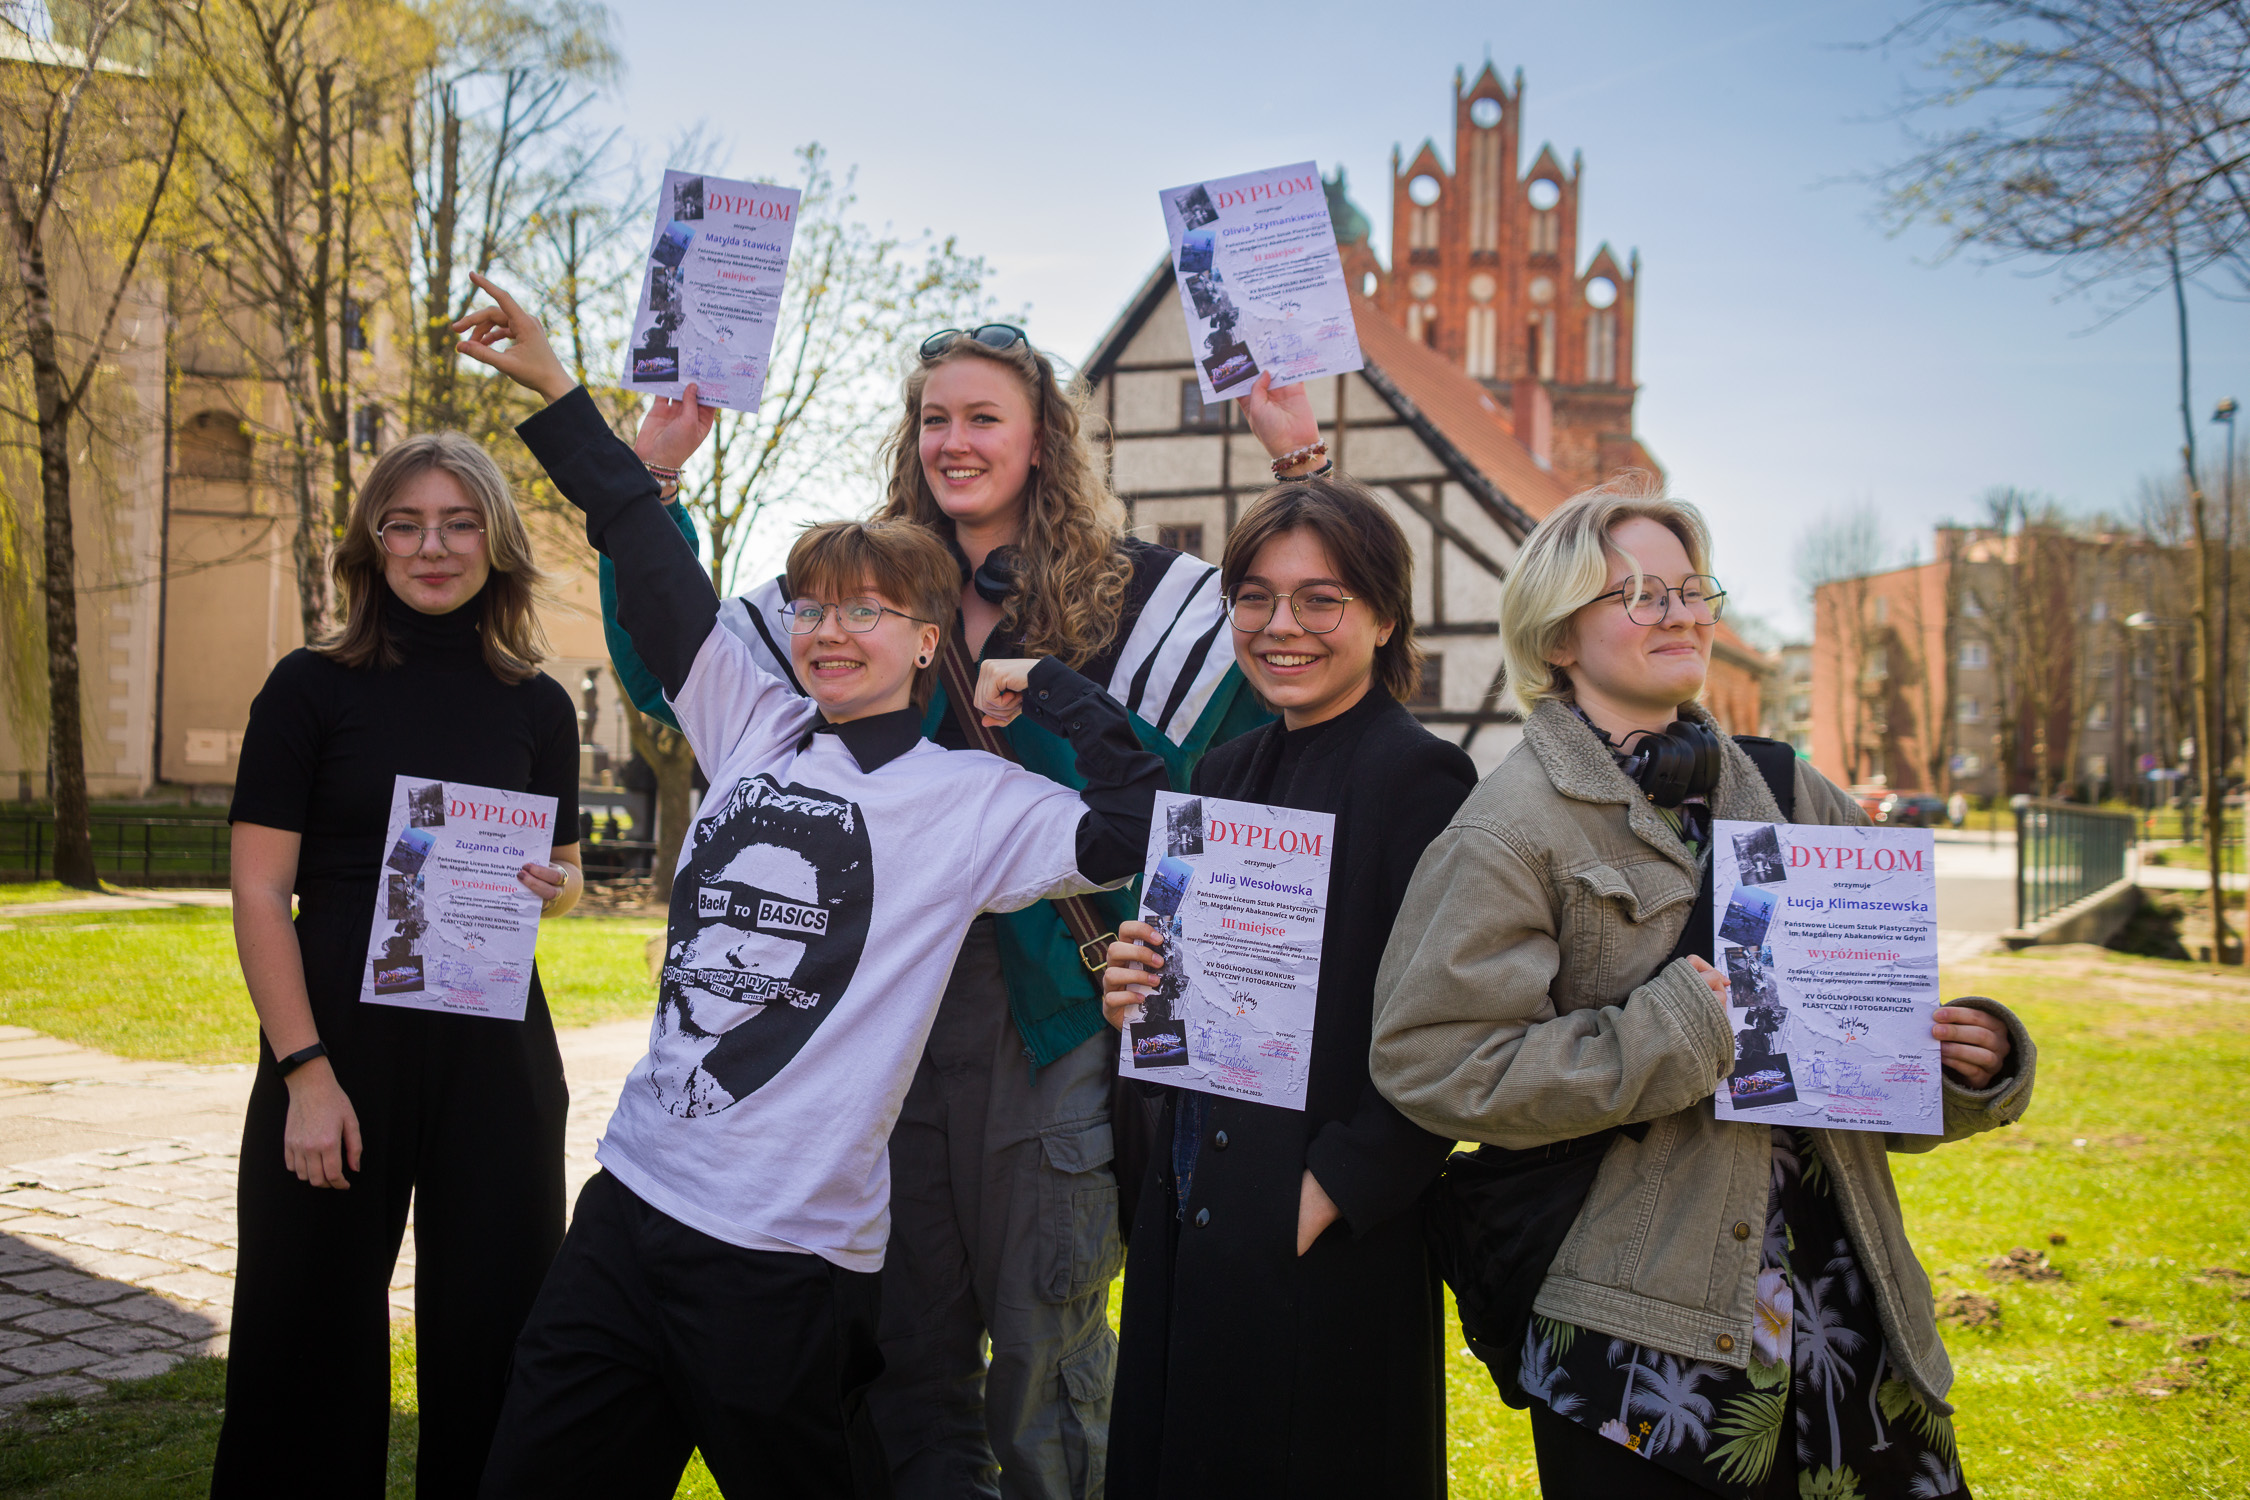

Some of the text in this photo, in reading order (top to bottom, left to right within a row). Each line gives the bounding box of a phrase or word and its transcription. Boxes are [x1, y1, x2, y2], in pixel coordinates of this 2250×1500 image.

[1218, 176, 1314, 208] DYPLOM
[708, 193, 791, 222] DYPLOM
[1222, 210, 1327, 237] Olivia Szymankiewicz
[706, 232, 781, 252] Matylda Stawicka
[722, 270, 756, 282] miejsce
[450, 800, 548, 829] DYPLOM
[1208, 820, 1323, 856] DYPLOM
[455, 840, 525, 857] Zuzanna Ciba
[1244, 860, 1276, 868] otrzymuje
[1790, 846, 1924, 871] DYPLOM
[451, 879, 517, 893] wyróżnienie
[1210, 872, 1313, 896] Julia Wesołowska
[700, 894, 826, 929] Back TO BASICS
[1197, 890, 1232, 901] Państwowe
[1233, 896, 1256, 905] Liceum
[1276, 903, 1318, 914] Plastycznych
[1787, 897, 1928, 912] Łucja Klimaszewska
[1210, 902, 1244, 913] Magdaleny
[1246, 907, 1287, 918] Abakanowicz
[1296, 915, 1315, 924] Gdyni
[1221, 918, 1286, 937] III miejsce
[1802, 931, 1842, 939] Magdaleny
[1844, 932, 1893, 940] Abakanowicz
[1879, 925, 1928, 933] Plastycznych
[1808, 948, 1900, 961] wyróżnienie
[1203, 969, 1241, 981] PLASTYCZNY
[1246, 977, 1296, 990] FOTOGRAFICZNY
[1216, 961, 1263, 976] OGÓLNOPOLSKI
[1265, 971, 1295, 980] KONKURS
[736, 975, 769, 991] Any
[1802, 1002, 1848, 1010] PLASTYCZNY
[1816, 994, 1874, 1002] OGÓLNOPOLSKI
